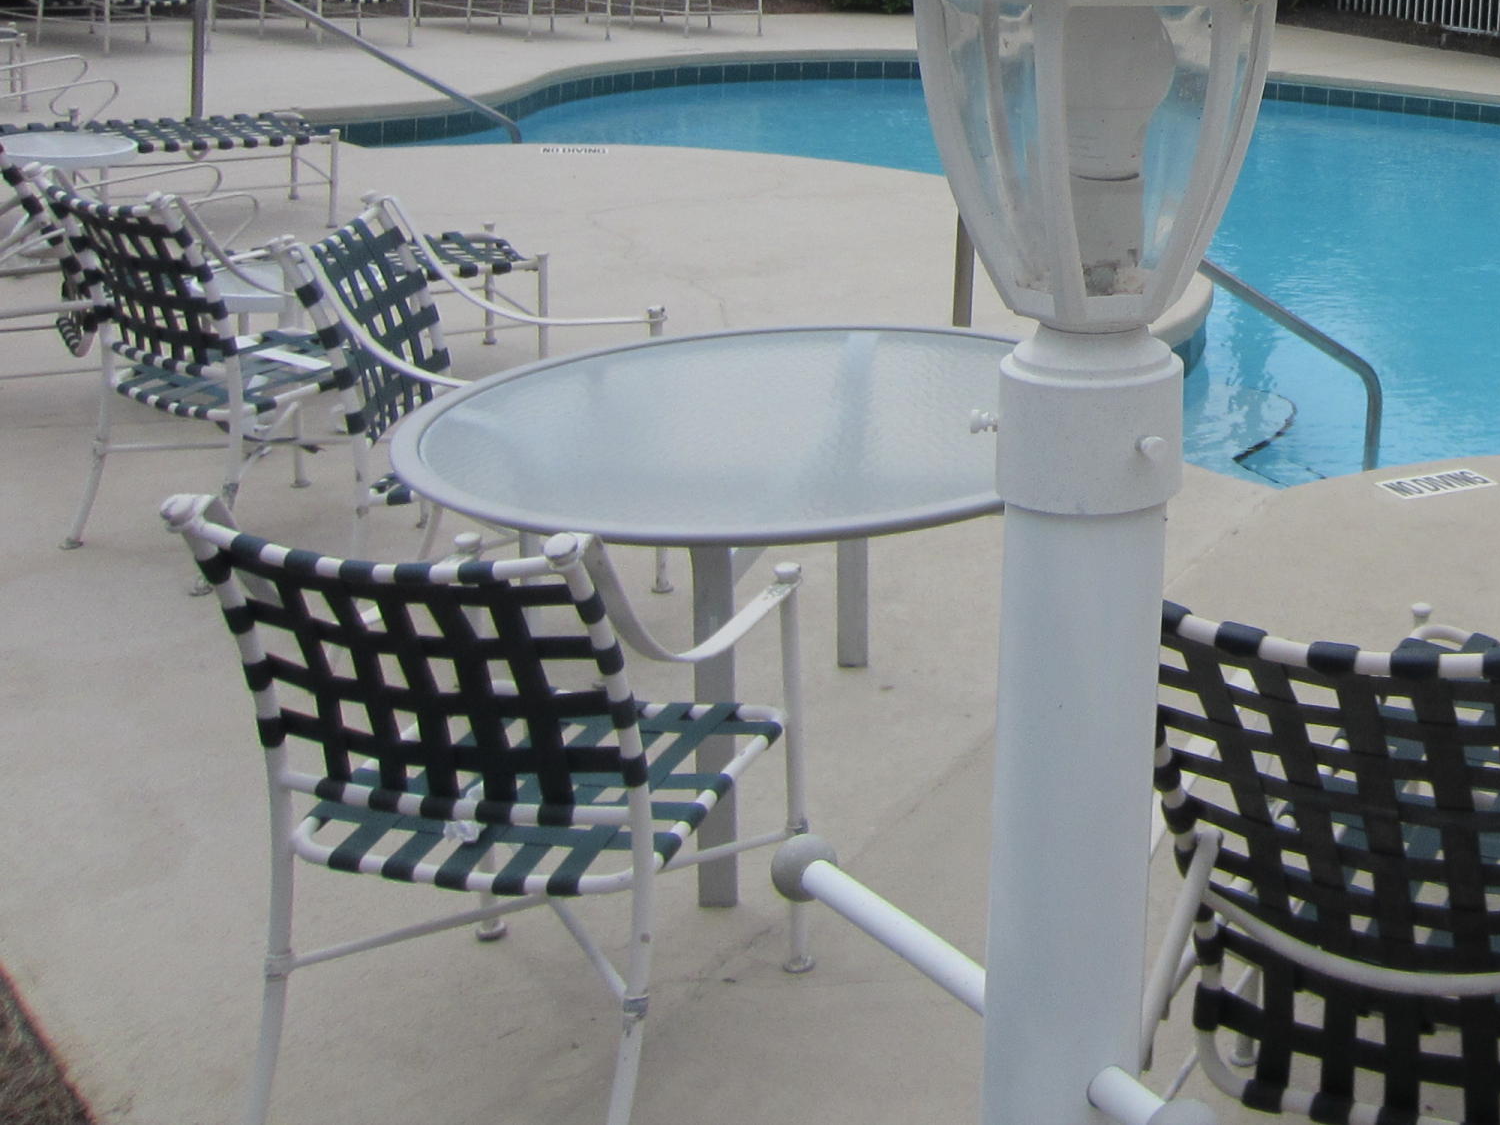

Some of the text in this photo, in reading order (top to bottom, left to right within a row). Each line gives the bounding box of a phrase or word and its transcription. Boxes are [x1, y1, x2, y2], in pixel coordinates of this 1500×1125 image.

[541, 146, 606, 154] NO DIVING
[1382, 470, 1490, 497] NO DIVING
